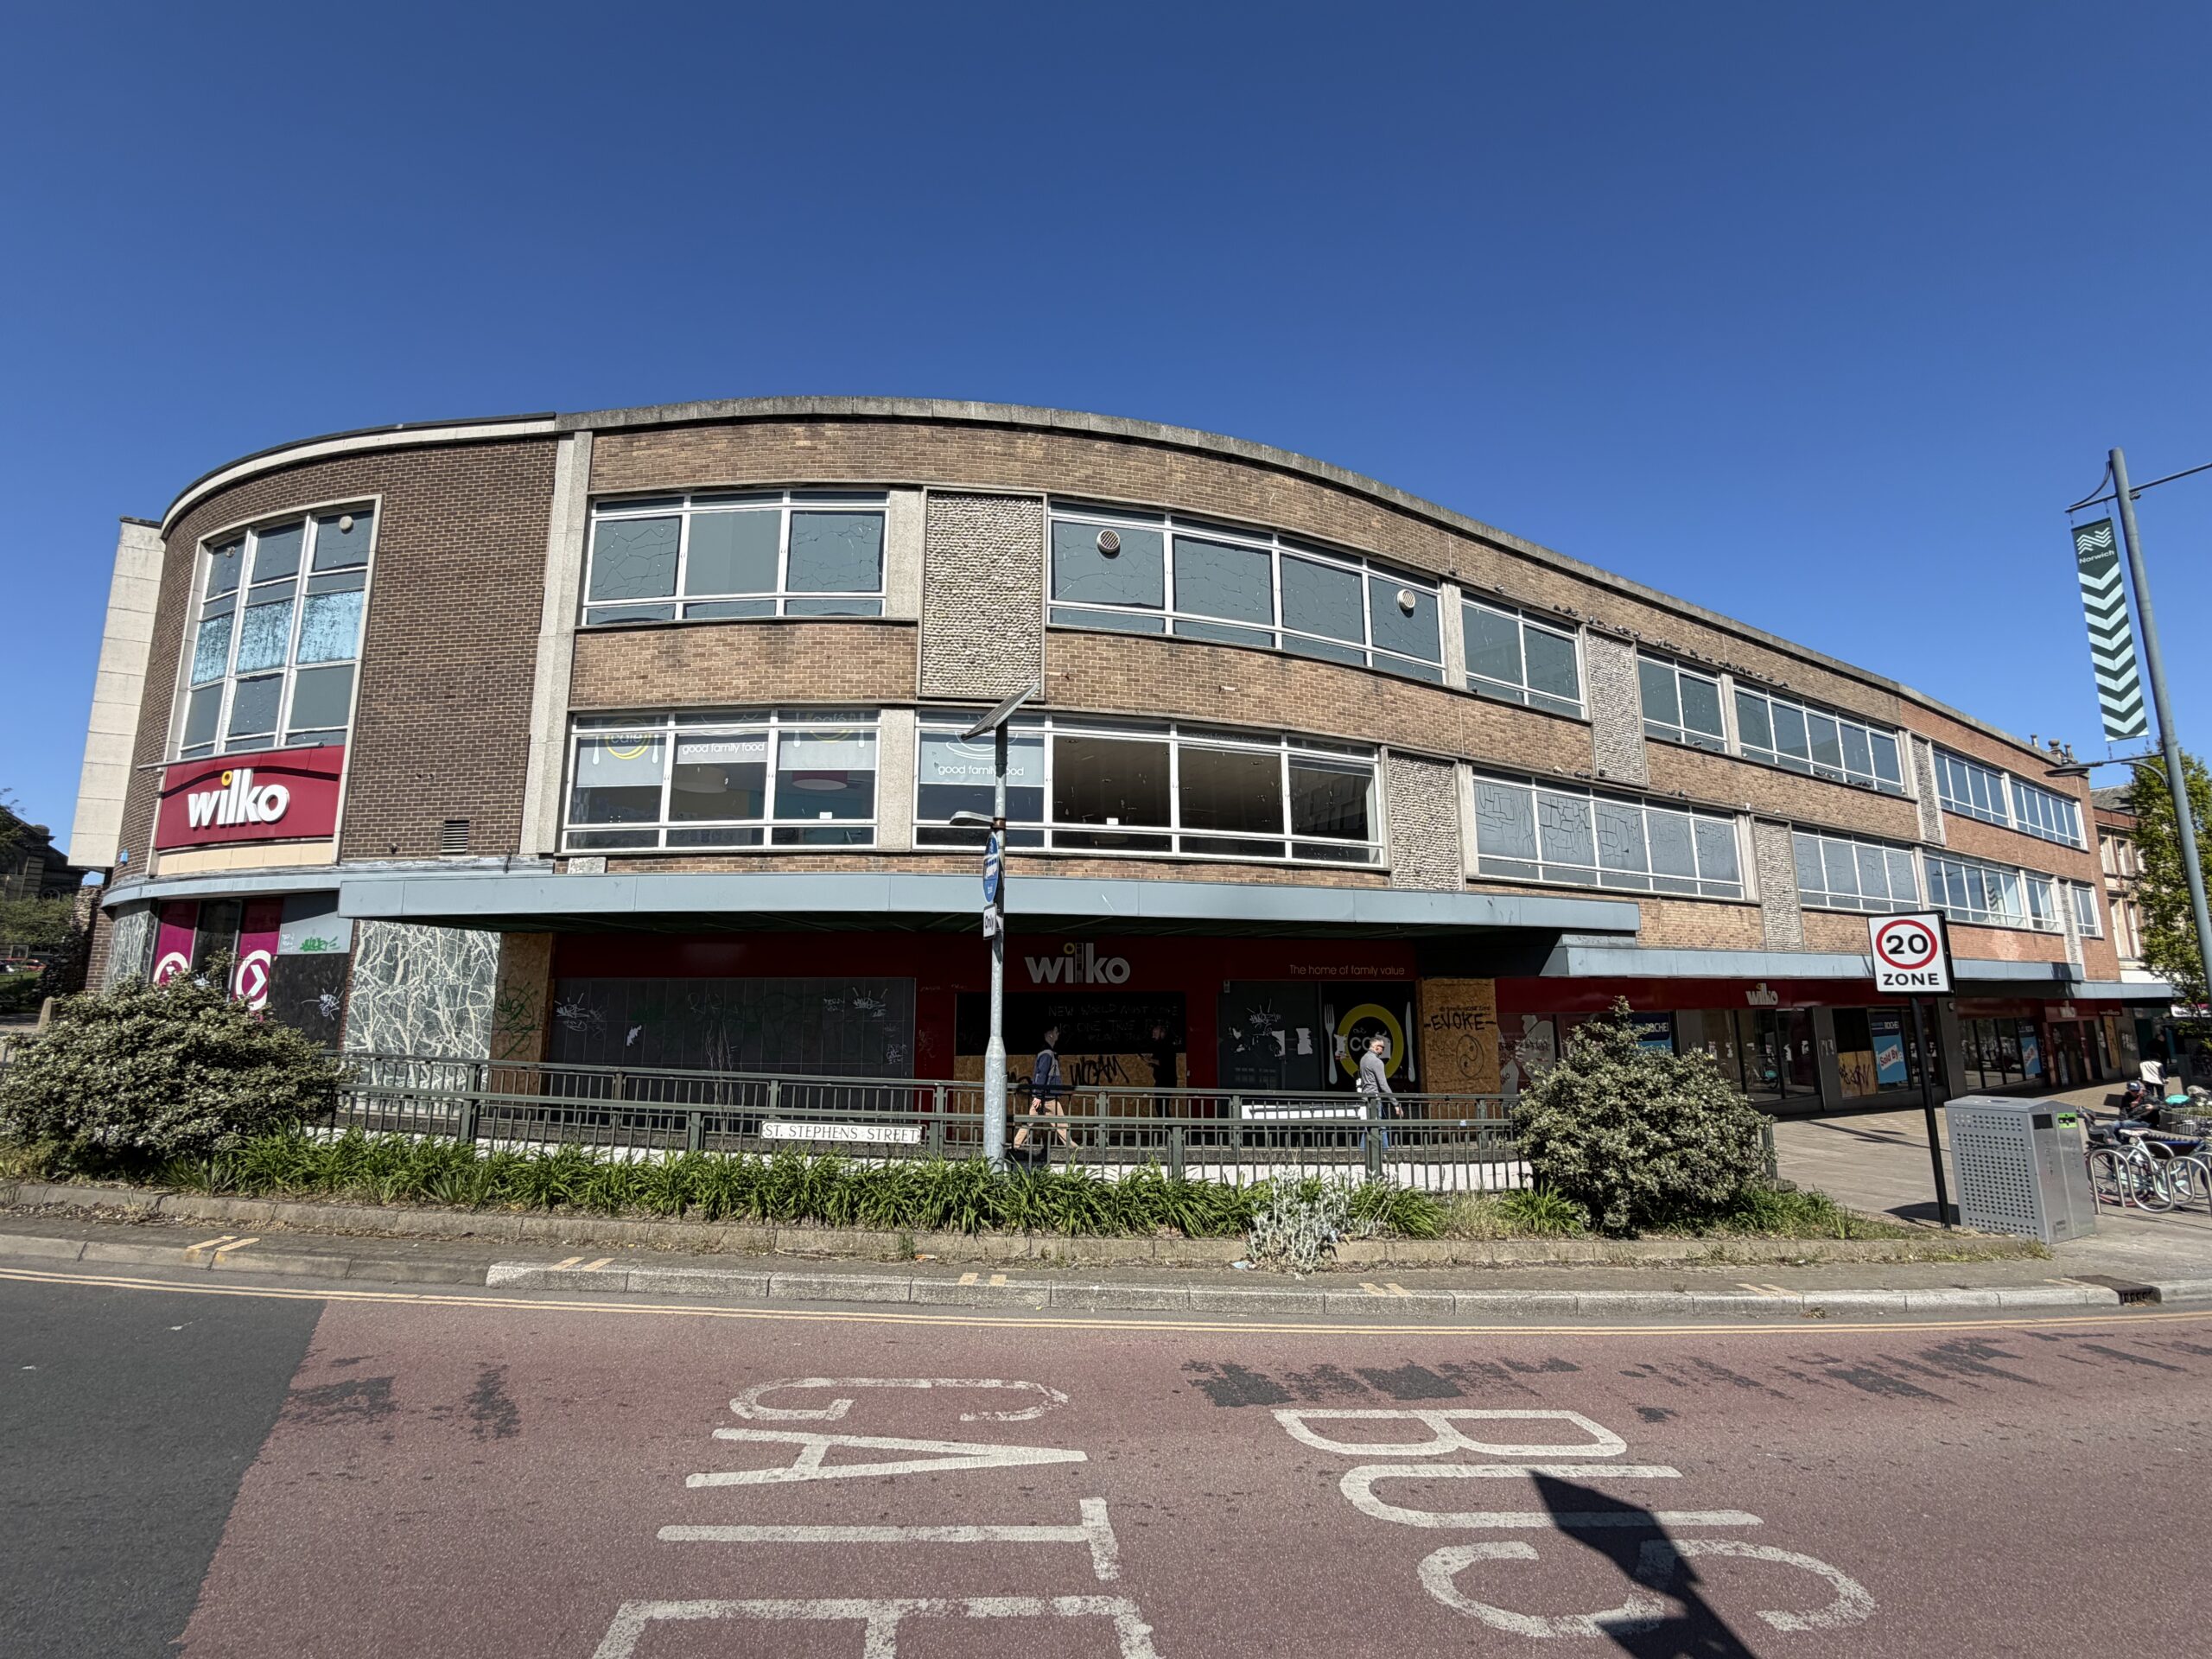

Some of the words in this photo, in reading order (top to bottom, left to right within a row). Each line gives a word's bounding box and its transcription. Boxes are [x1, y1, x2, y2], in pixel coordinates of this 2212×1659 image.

[2079, 550, 2114, 563] Norwich
[682, 744, 709, 754] good
[710, 743, 740, 754] family
[741, 742, 765, 753] food
[938, 765, 966, 776] good
[1007, 767, 1024, 776] ood
[188, 768, 290, 829] wilko
[1885, 933, 1929, 955] 20
[1024, 941, 1131, 984] wilko
[1289, 964, 1306, 975] The
[1308, 963, 1337, 975] home
[1338, 964, 1348, 975] of
[1351, 964, 1378, 977] family
[1380, 964, 1405, 976] value
[1882, 973, 1940, 986] ZONE
[1745, 982, 1779, 1006] wilko
[1879, 1052, 1891, 1066] Sold
[1891, 1049, 1898, 1060] By
[765, 1125, 784, 1137] ST.
[788, 1125, 858, 1140] STEPHENS
[867, 1128, 918, 1141] STREET
[1271, 1409, 1879, 1638] BUS
